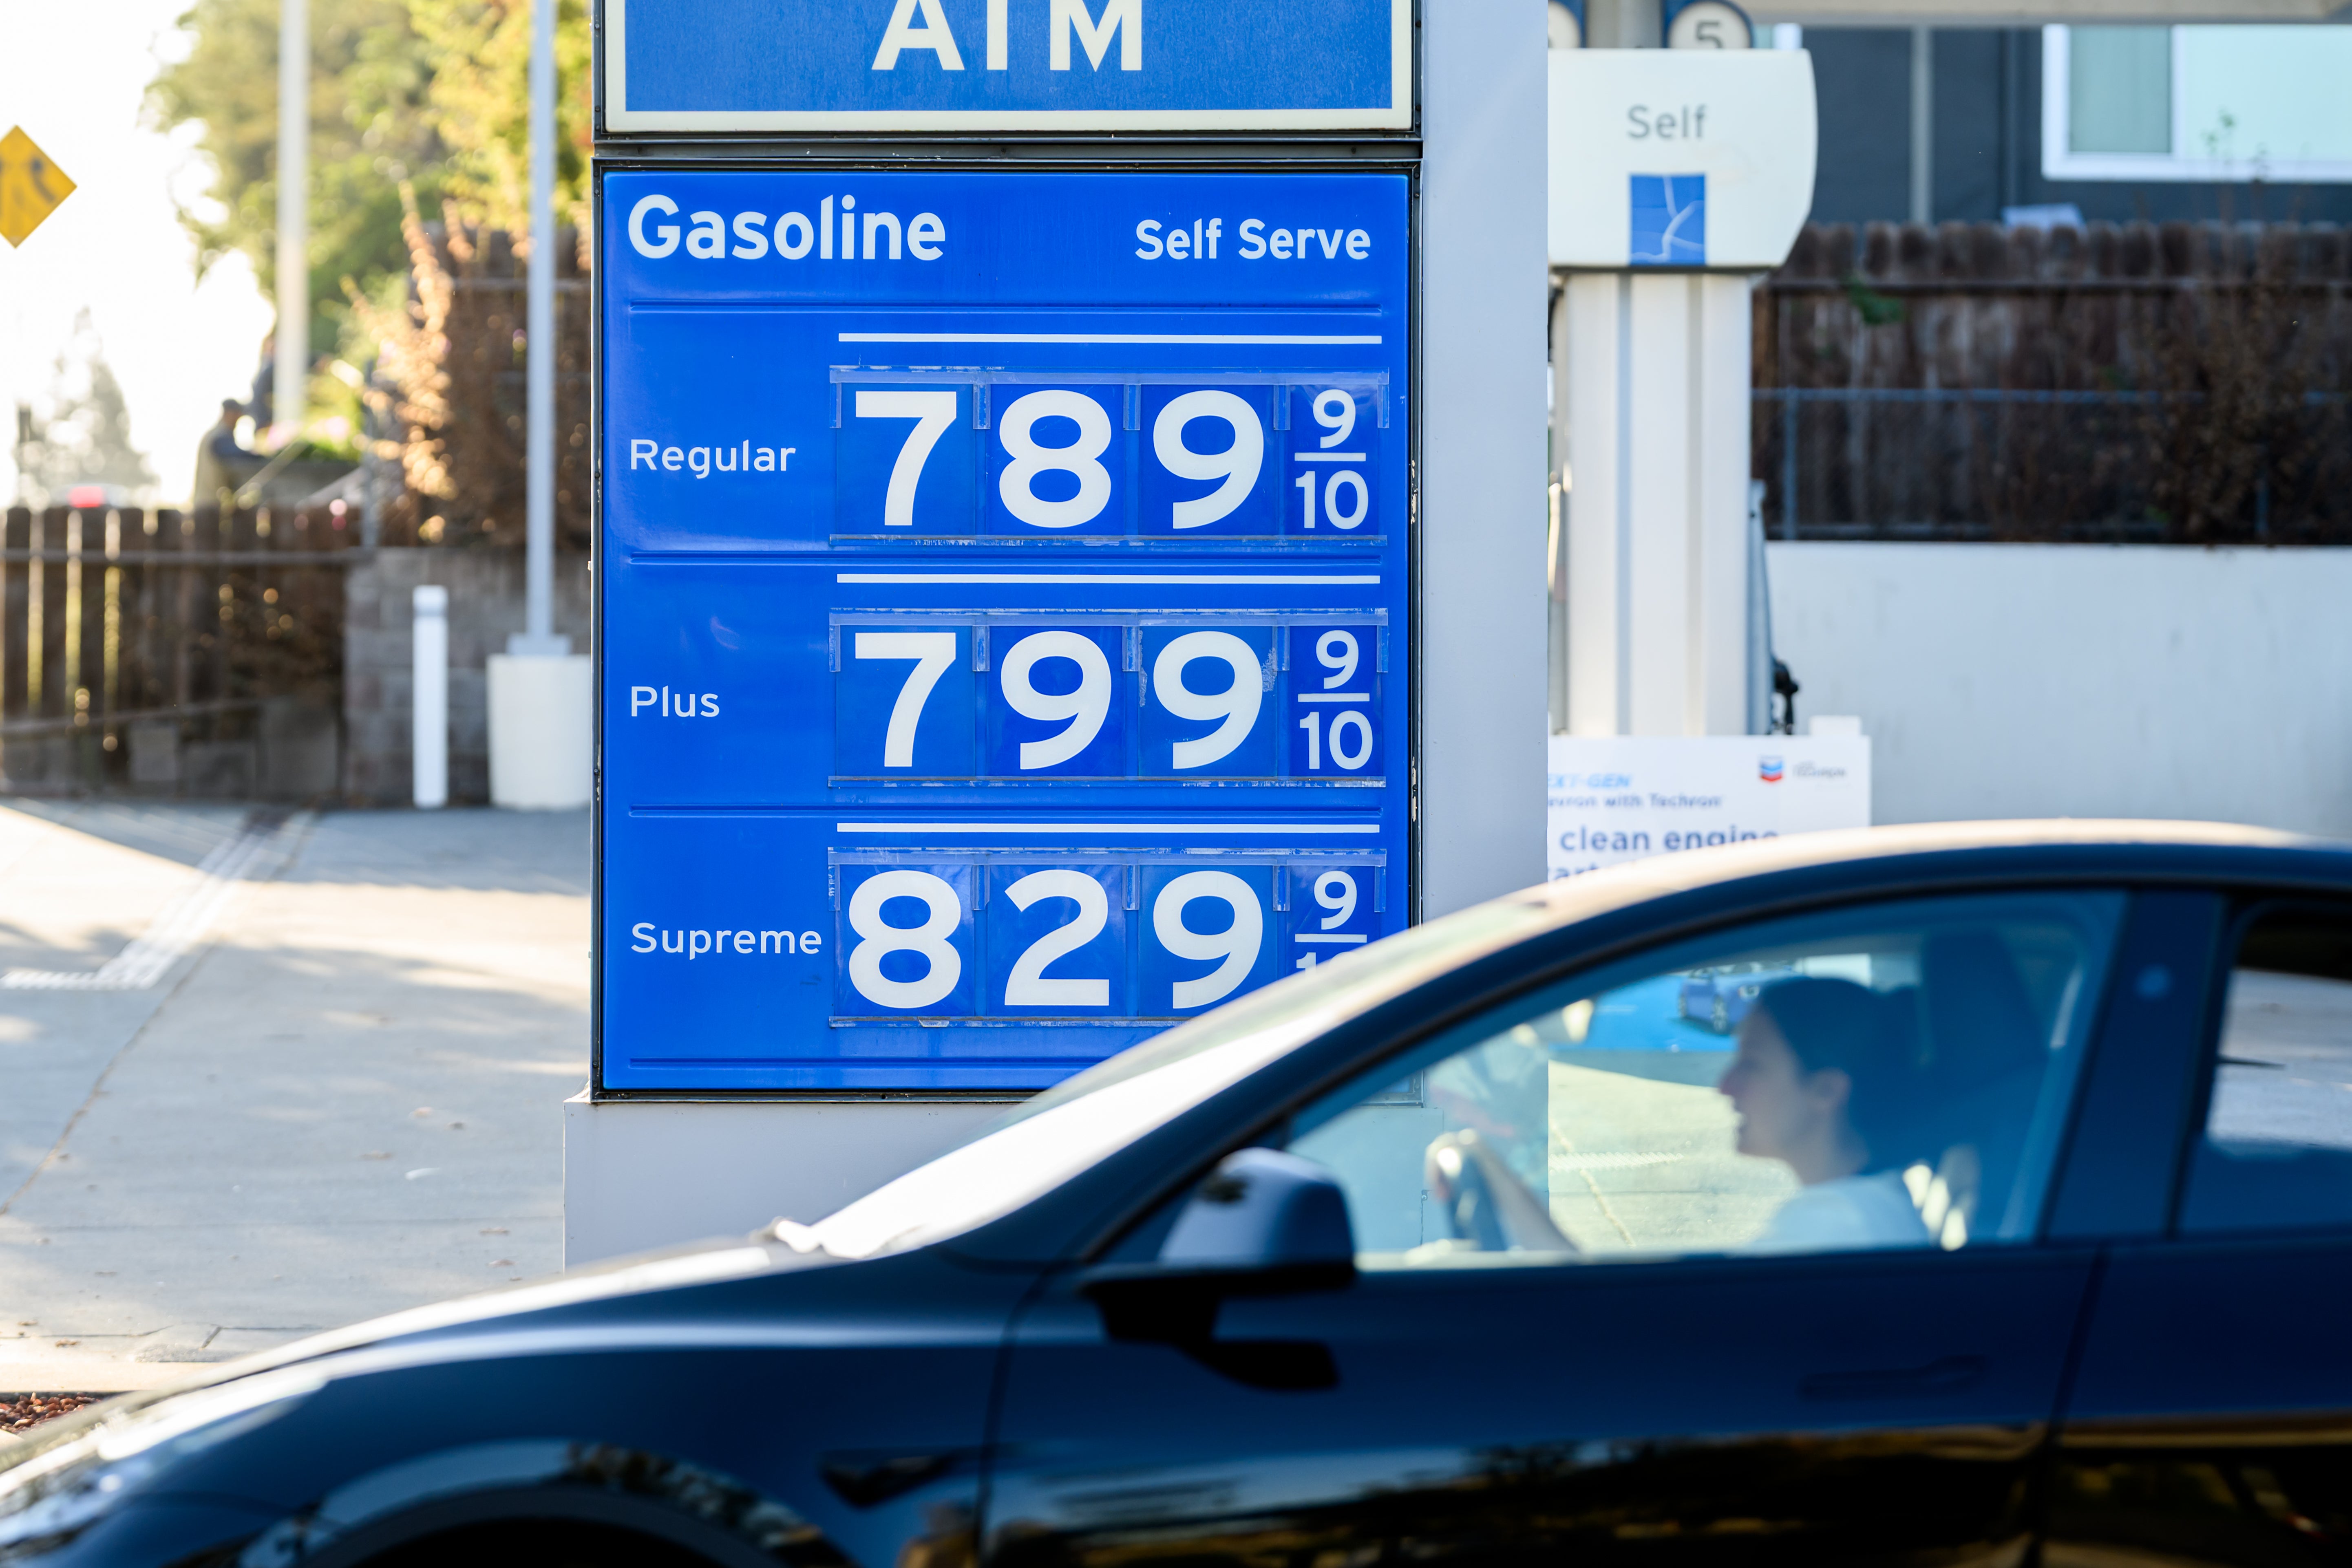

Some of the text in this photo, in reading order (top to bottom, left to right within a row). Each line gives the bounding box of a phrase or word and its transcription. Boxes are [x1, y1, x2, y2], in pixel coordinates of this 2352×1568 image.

[1627, 105, 1707, 139] Self
[628, 194, 945, 260] Gasoline
[1135, 218, 1370, 260] Self Serve
[1313, 389, 1356, 448] 9
[631, 390, 1264, 529] Regular 789
[1295, 470, 1369, 529] 10
[1316, 630, 1359, 689] 9
[632, 631, 1263, 770] Plus 799
[1299, 710, 1373, 770] 10
[1606, 794, 1642, 807] with
[1561, 826, 1650, 850] clean
[1314, 871, 1357, 930] 9
[631, 869, 1263, 1009] Supreme 829
